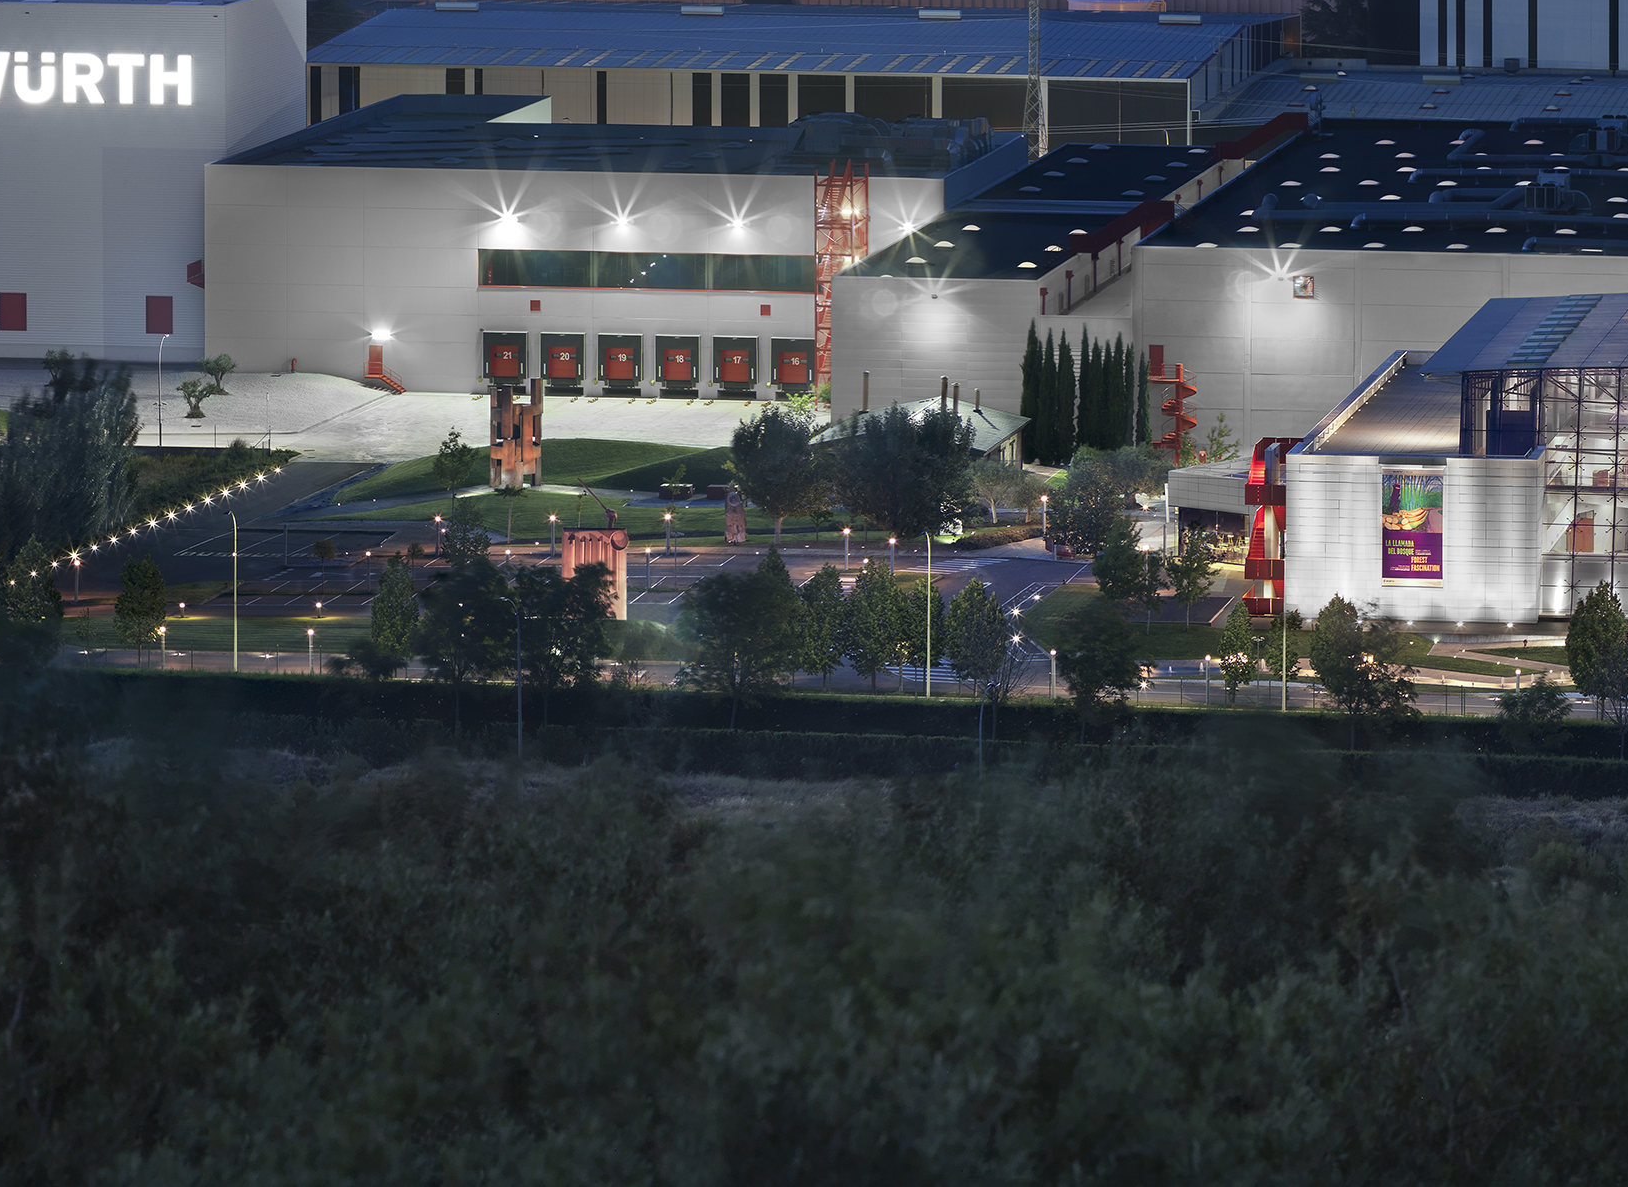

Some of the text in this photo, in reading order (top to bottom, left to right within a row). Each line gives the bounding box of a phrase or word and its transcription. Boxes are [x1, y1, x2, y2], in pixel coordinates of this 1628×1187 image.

[503, 351, 512, 359] 21
[560, 352, 570, 361] 20
[618, 353, 627, 362] 19
[675, 355, 684, 363] 18
[733, 356, 742, 364] 17
[791, 357, 800, 365] 16
[1397, 548, 1414, 556] BOSQUE
